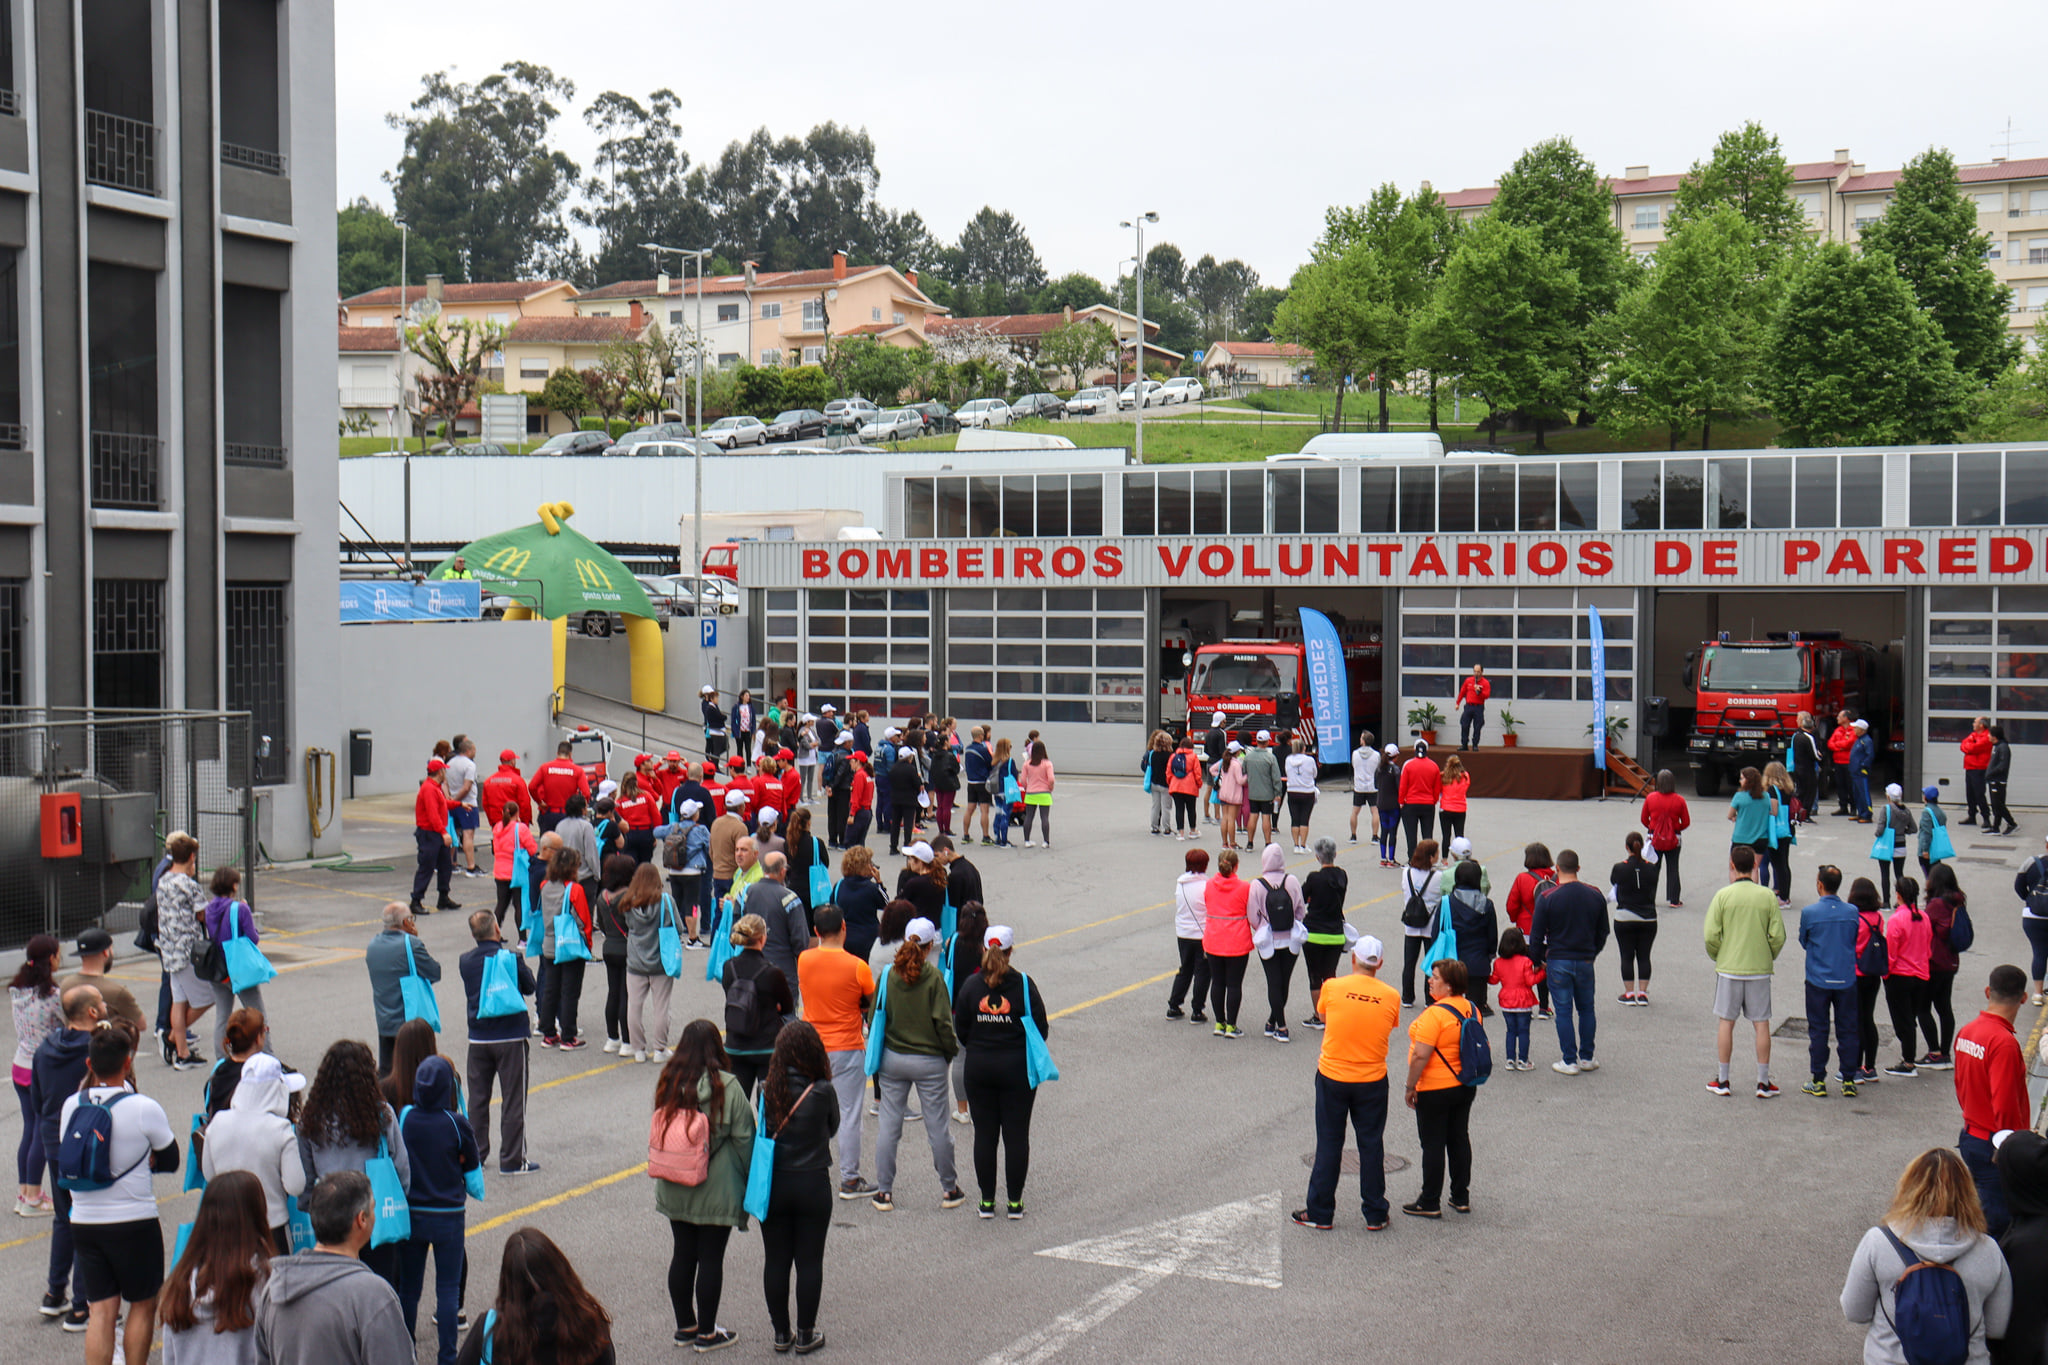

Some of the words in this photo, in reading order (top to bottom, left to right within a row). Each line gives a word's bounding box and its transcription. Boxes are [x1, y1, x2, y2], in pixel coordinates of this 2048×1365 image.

[803, 546, 1123, 579] BOMBEIROS
[1158, 538, 1613, 577] VOLUNTÁRIOS
[1655, 541, 1738, 576] DE
[1785, 537, 2048, 575] PARED
[704, 621, 714, 646] P
[977, 1014, 1004, 1023] BRUNA
